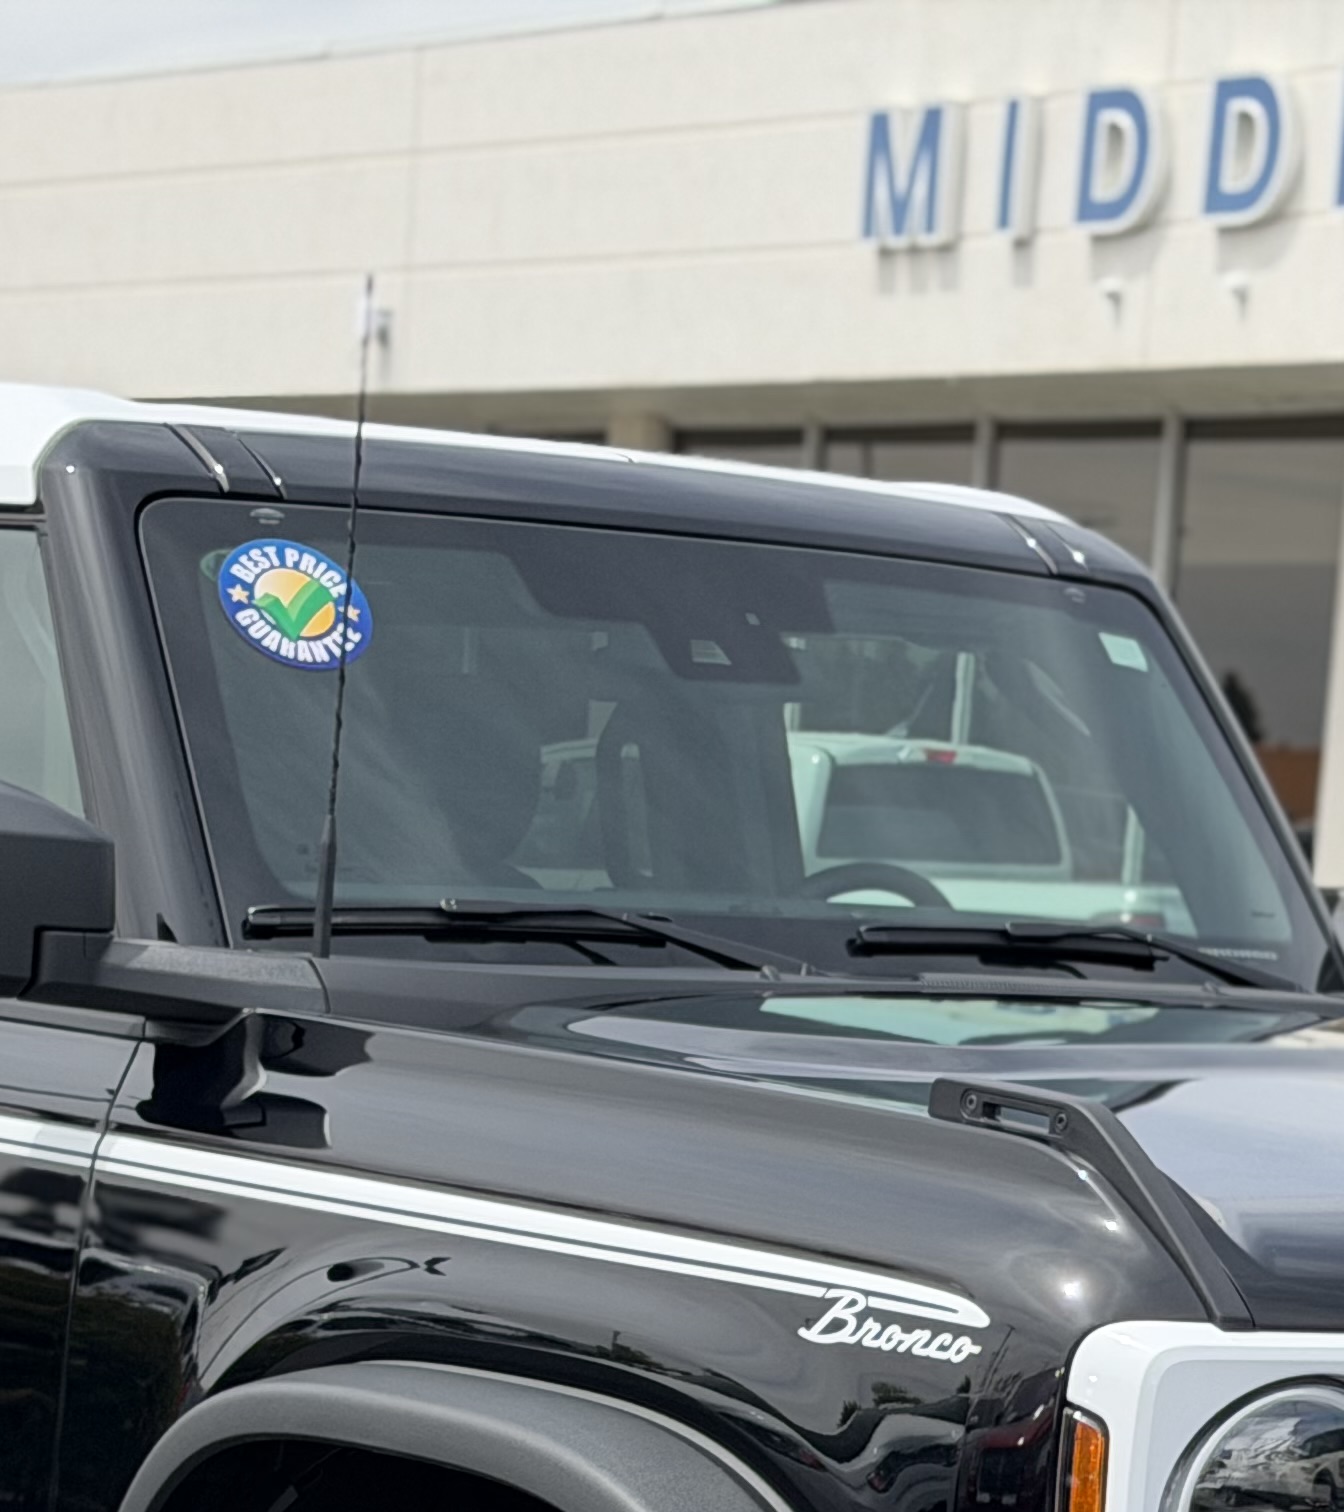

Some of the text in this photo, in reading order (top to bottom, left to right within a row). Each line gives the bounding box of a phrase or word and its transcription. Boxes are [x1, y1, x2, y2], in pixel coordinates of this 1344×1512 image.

[229, 545, 348, 599] BEST PRICE
[797, 1288, 983, 1364] Bronco
